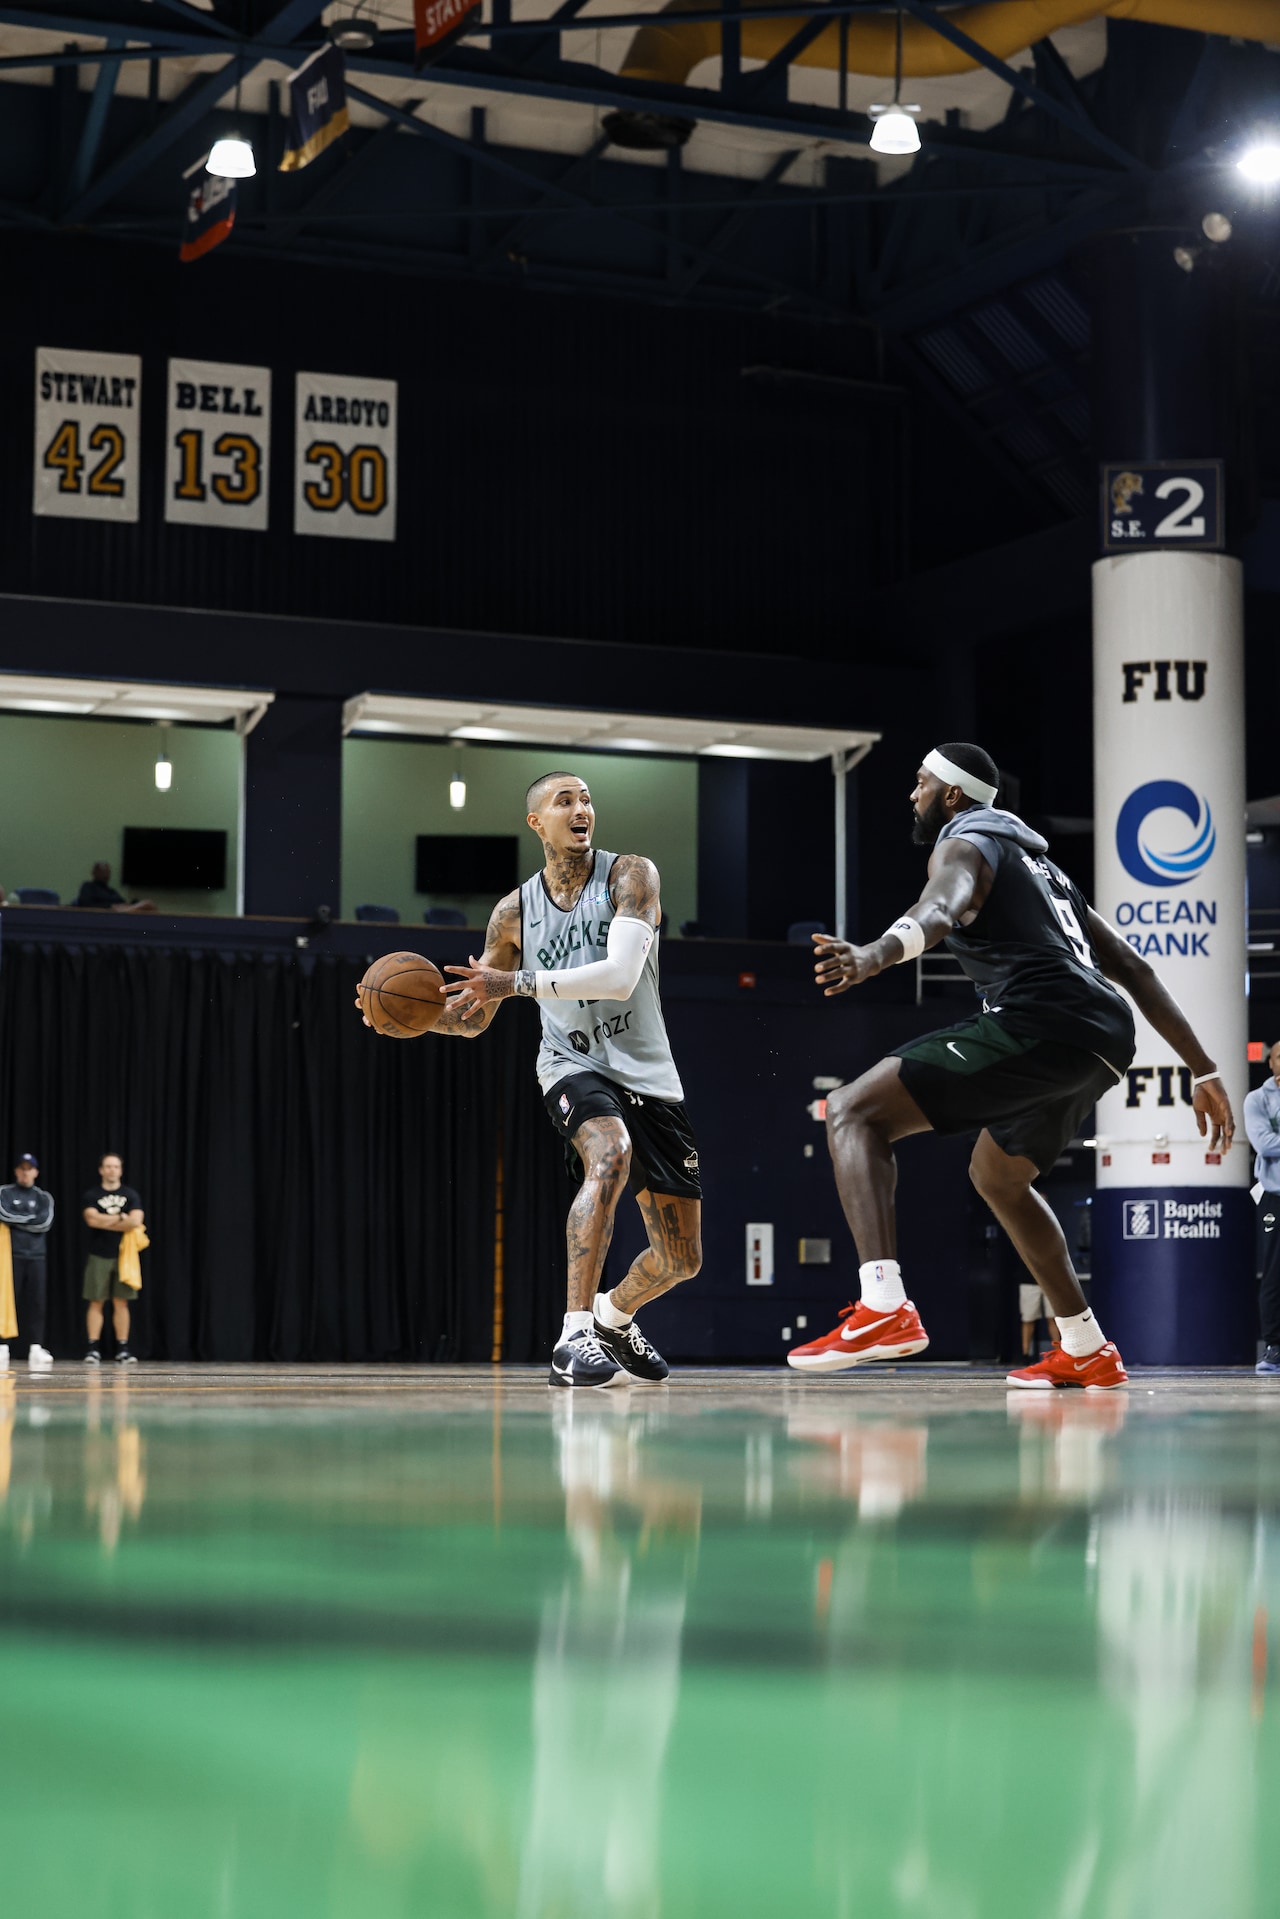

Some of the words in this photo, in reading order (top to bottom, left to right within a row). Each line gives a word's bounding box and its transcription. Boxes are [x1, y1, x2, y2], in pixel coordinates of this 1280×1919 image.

[40, 370, 136, 408] STEWART
[175, 381, 263, 417] BELL
[303, 394, 390, 429] ARROYO
[44, 419, 126, 498] 42
[173, 428, 263, 506] 13
[303, 440, 388, 516] 30
[1154, 476, 1206, 538] 2
[1111, 519, 1146, 538] S.E.
[1122, 660, 1208, 704] FIU
[1115, 900, 1217, 927] OCEAN
[536, 920, 611, 971] BUCKS
[1126, 932, 1210, 957] BANK
[593, 1010, 632, 1045] rozr
[1163, 1200, 1223, 1222] Baptist
[1163, 1220, 1221, 1239] Health
